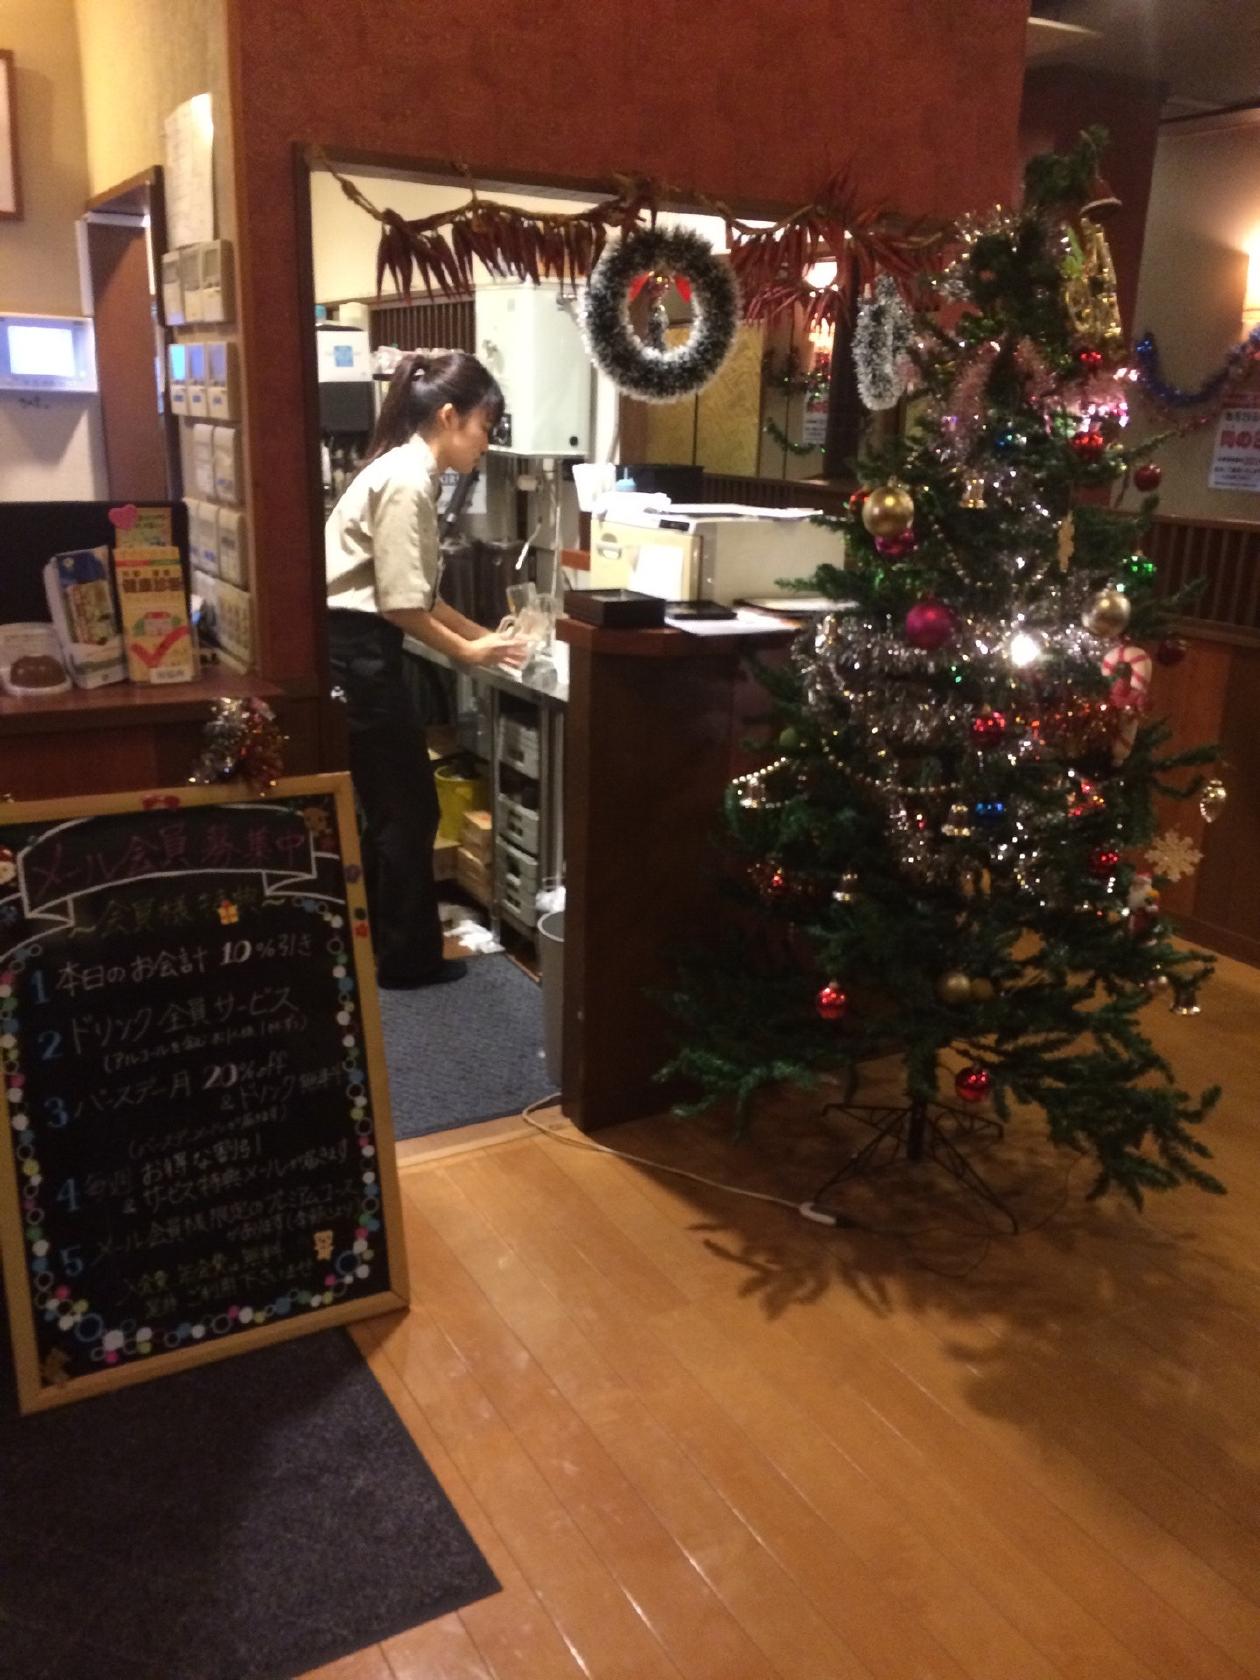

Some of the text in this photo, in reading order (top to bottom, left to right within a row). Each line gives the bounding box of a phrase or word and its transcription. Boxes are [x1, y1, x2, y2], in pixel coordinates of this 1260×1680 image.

[32, 828, 308, 897] メール会員募集中
[31, 933, 311, 1004] 1 本日のお会計 10%引き
[37, 1030, 62, 1061] 2
[43, 1097, 69, 1128] 3
[56, 1177, 80, 1212] 4
[60, 1244, 84, 1276] 5
